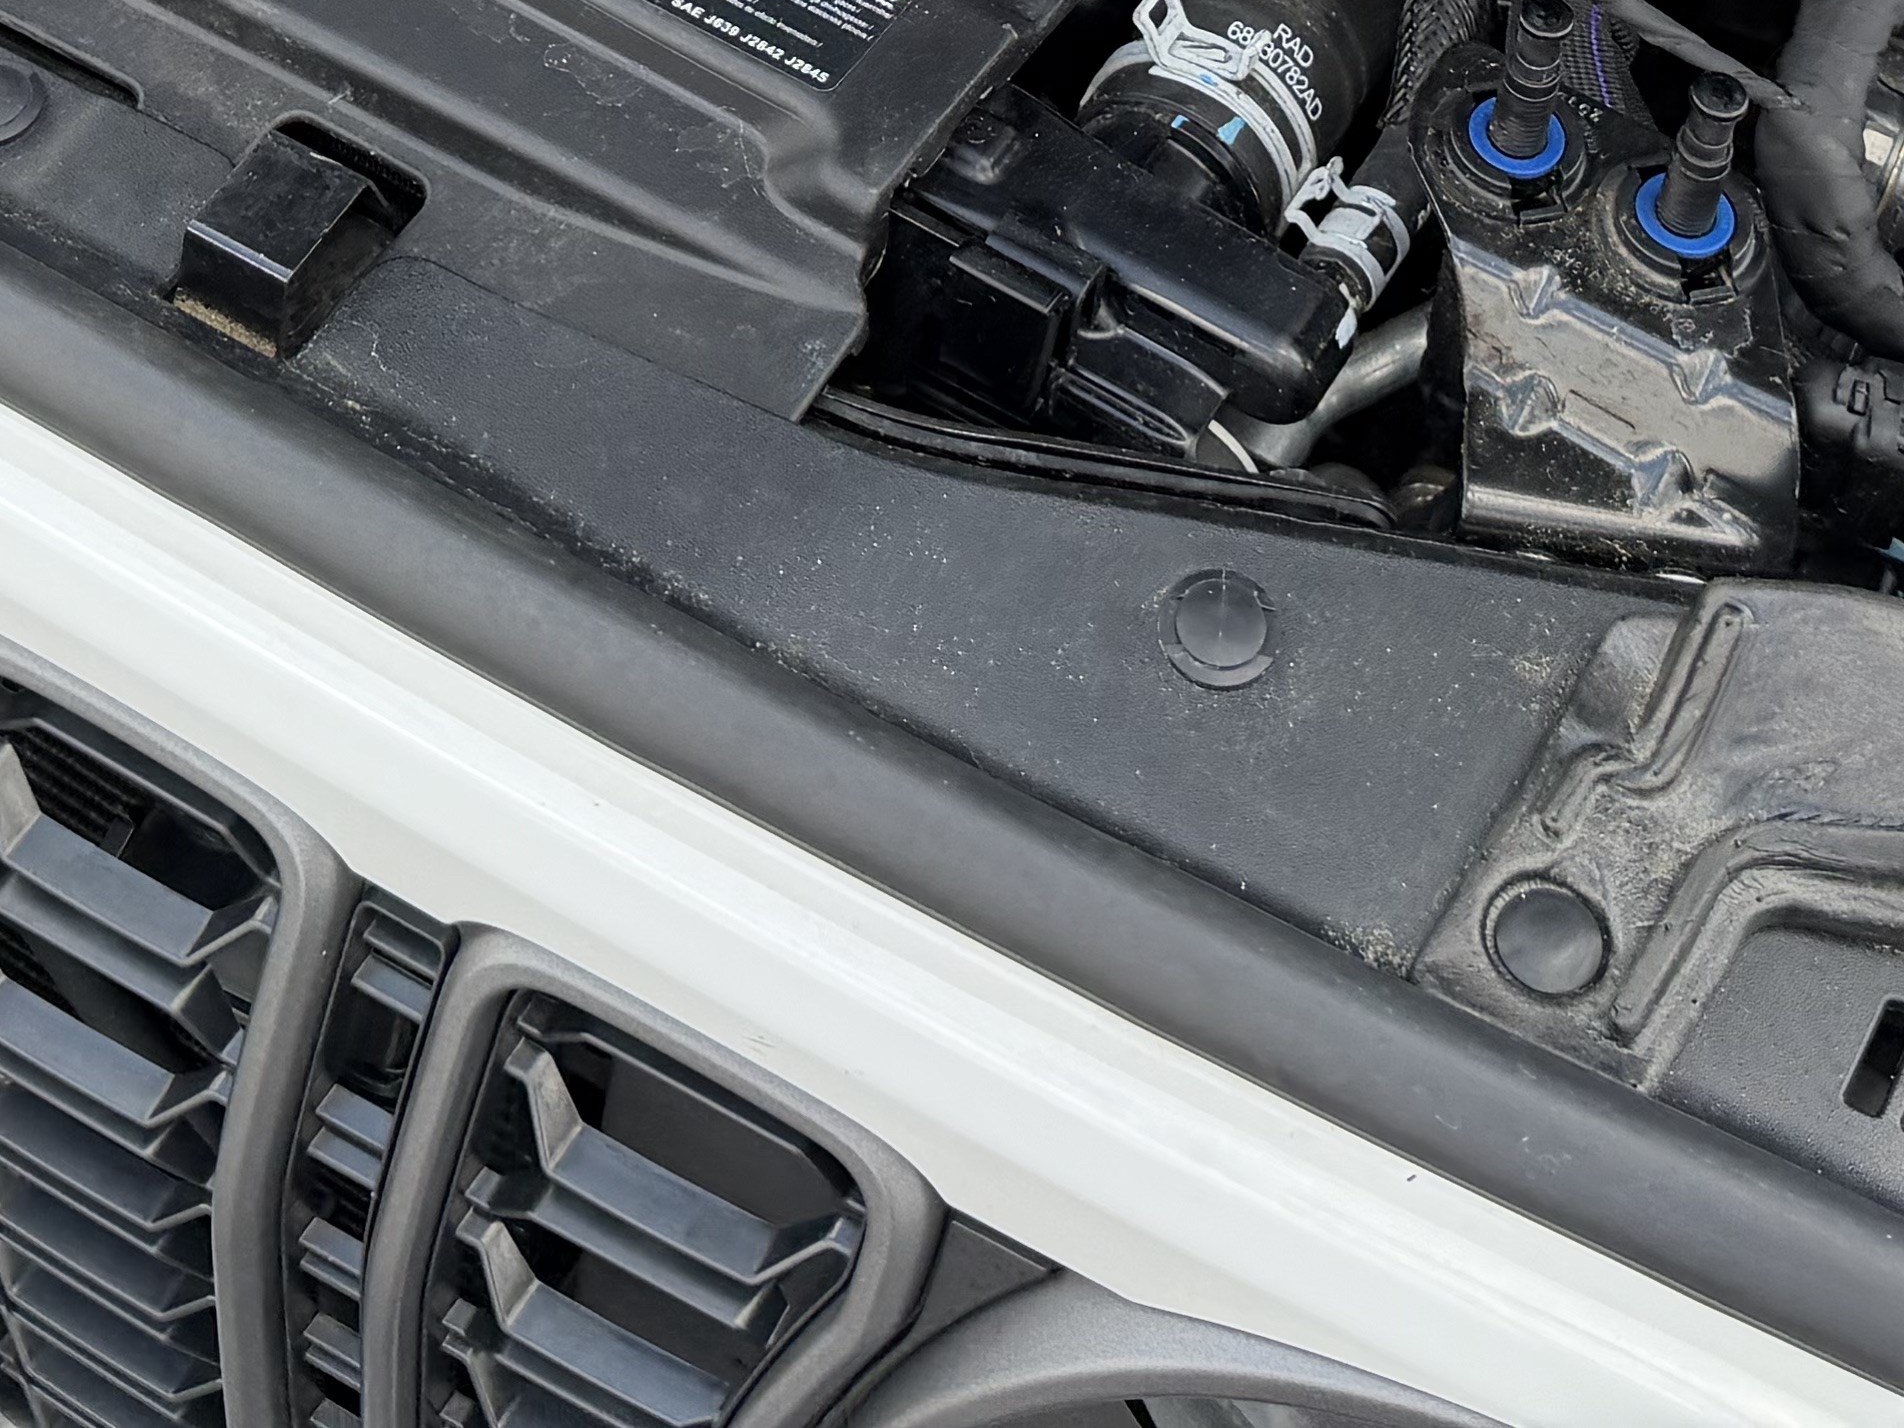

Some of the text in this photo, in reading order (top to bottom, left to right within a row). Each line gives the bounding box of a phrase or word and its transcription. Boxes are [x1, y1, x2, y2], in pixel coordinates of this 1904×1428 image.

[703, 15, 740, 36] J639
[1273, 23, 1315, 69] RAD
[1227, 20, 1323, 121] 6830782AD
